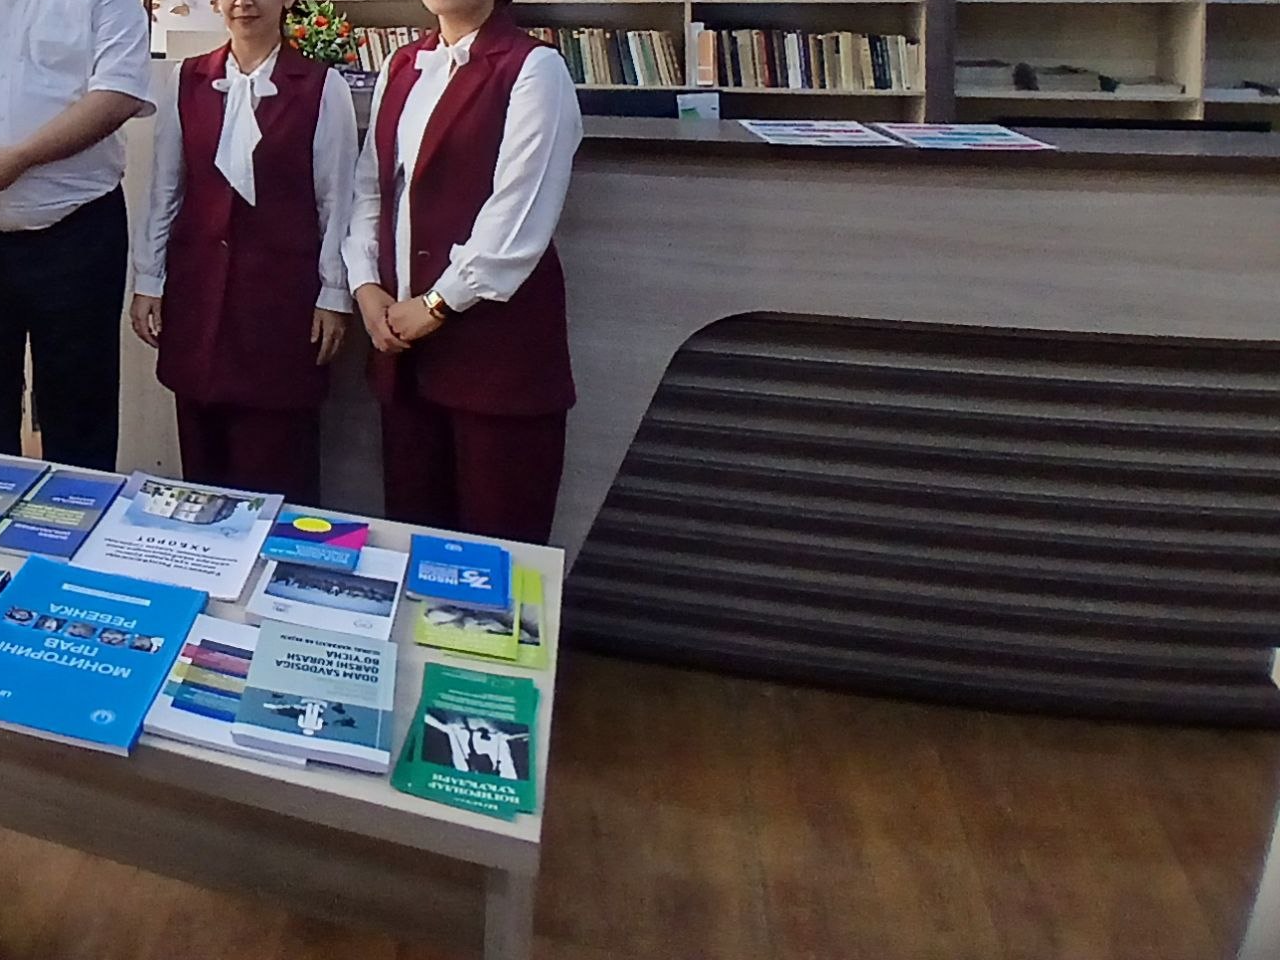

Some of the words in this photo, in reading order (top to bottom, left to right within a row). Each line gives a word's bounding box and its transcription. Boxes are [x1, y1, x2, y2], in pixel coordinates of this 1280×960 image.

[136, 535, 211, 552] АХБОРОТ
[48, 601, 137, 630] РЕБЕНКА
[43, 635, 99, 658] ПРАВ
[286, 652, 333, 666] KURASH
[336, 661, 379, 674] QARSHI
[275, 660, 340, 677] SAVDOSIGA
[342, 670, 378, 683] ODAM
